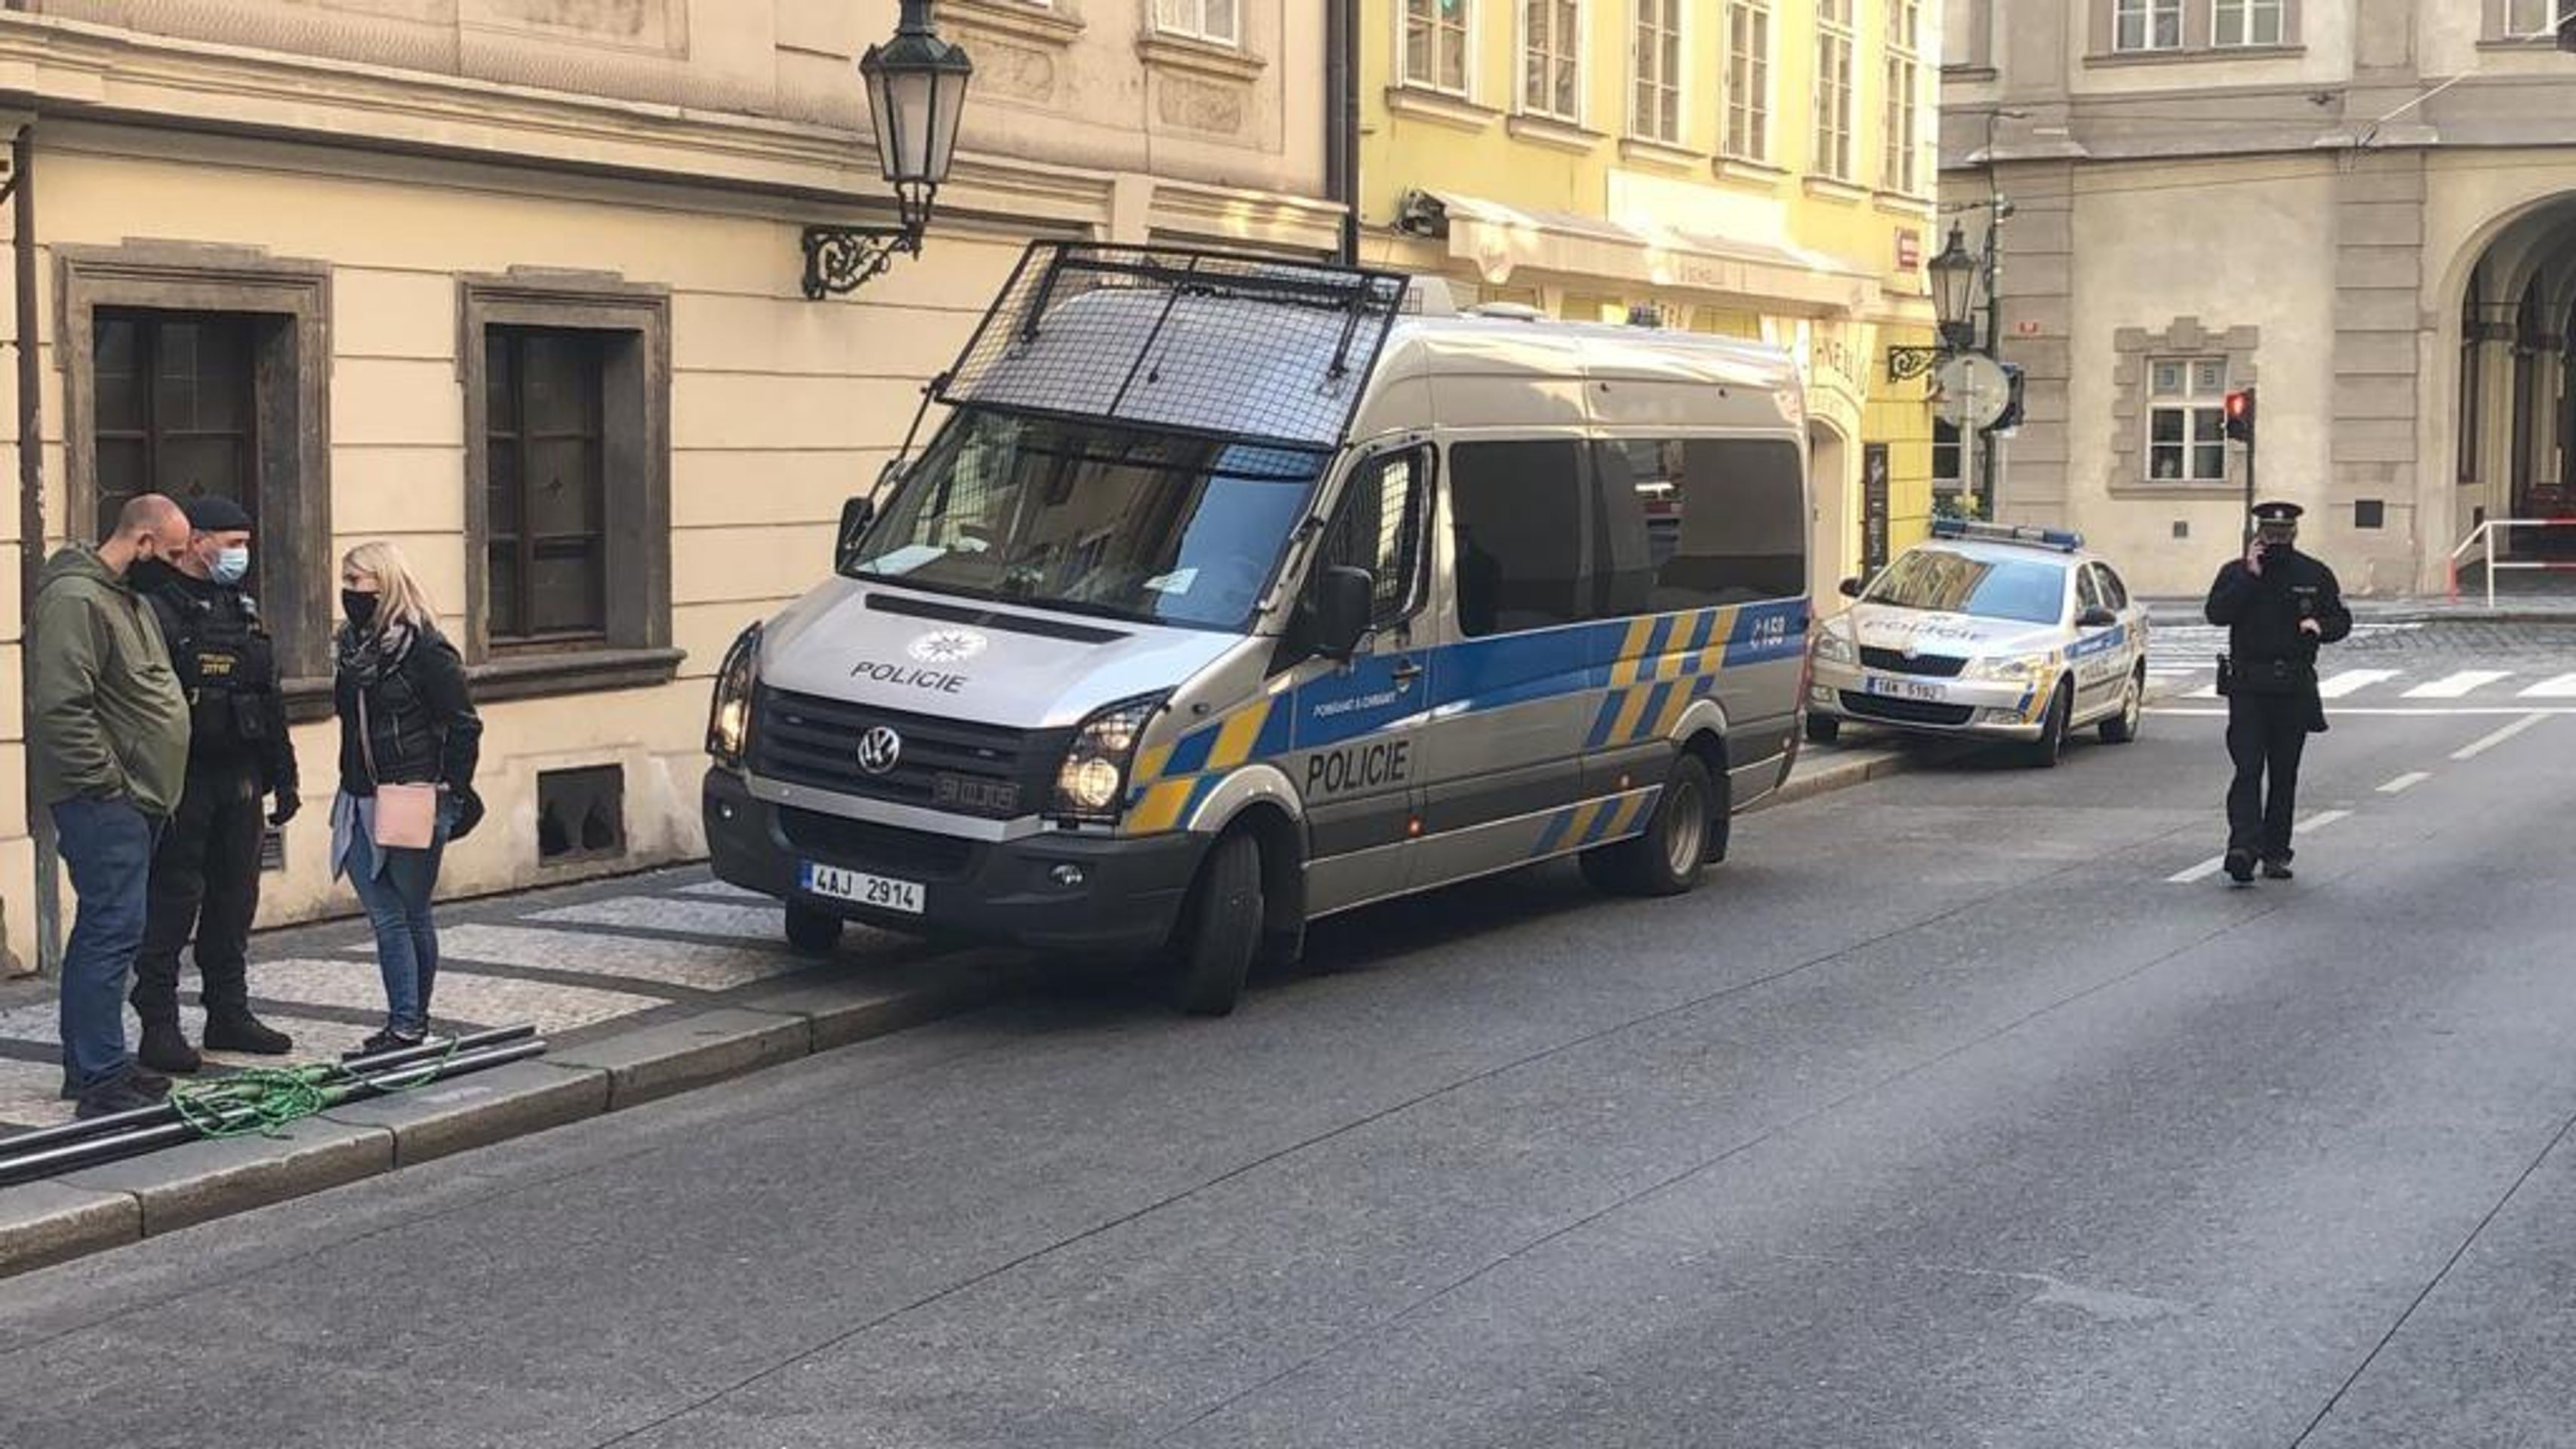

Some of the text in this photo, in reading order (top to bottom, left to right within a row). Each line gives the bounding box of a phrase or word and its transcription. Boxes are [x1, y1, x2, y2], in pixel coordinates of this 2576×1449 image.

[850, 661, 968, 693] POLICIE
[1306, 740, 1410, 797] POLICIE
[817, 869, 914, 908] 4AJ 2914
